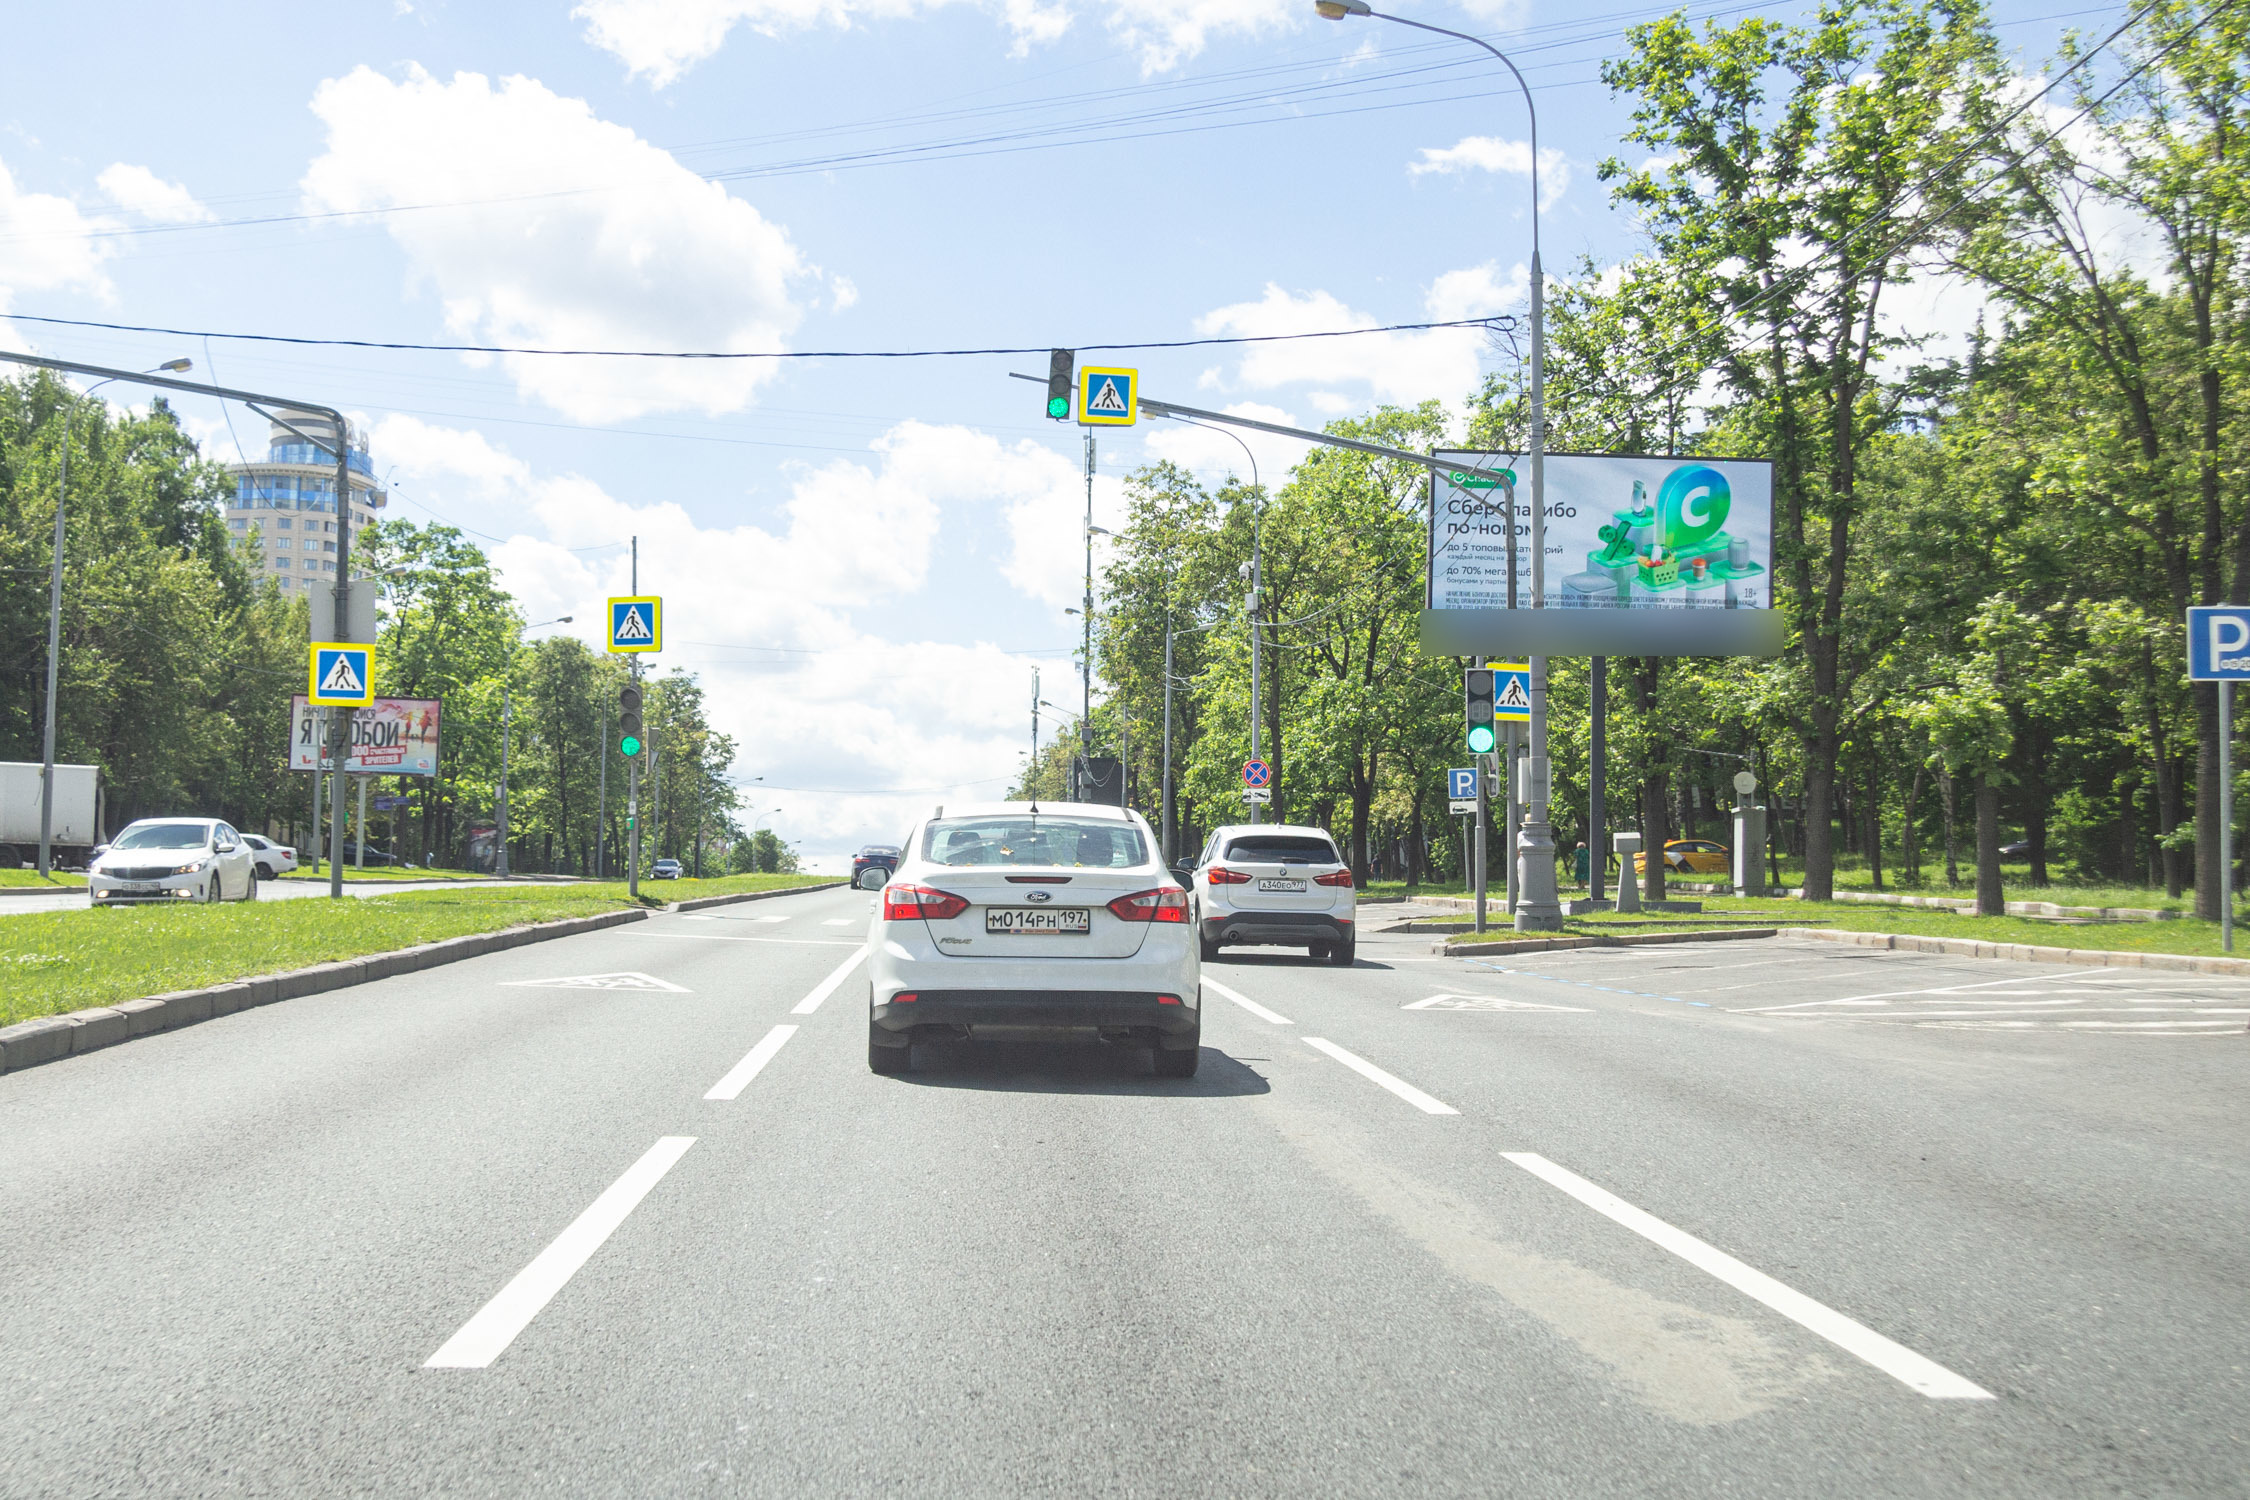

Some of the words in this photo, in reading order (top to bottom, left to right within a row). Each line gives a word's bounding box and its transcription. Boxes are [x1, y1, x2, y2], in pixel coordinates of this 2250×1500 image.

[1448, 499, 1576, 518] СберСпаибо
[1447, 544, 1460, 552] до
[1462, 543, 1468, 551] 5
[1471, 545, 1506, 553] топовы
[1446, 567, 1459, 576] до
[1461, 566, 1482, 576] 70%
[1744, 588, 1757, 599] 18+
[2209, 615, 2249, 672] P
[351, 718, 400, 747] ОБОЙ
[1456, 772, 1473, 795] P
[1060, 911, 1084, 924] 197
